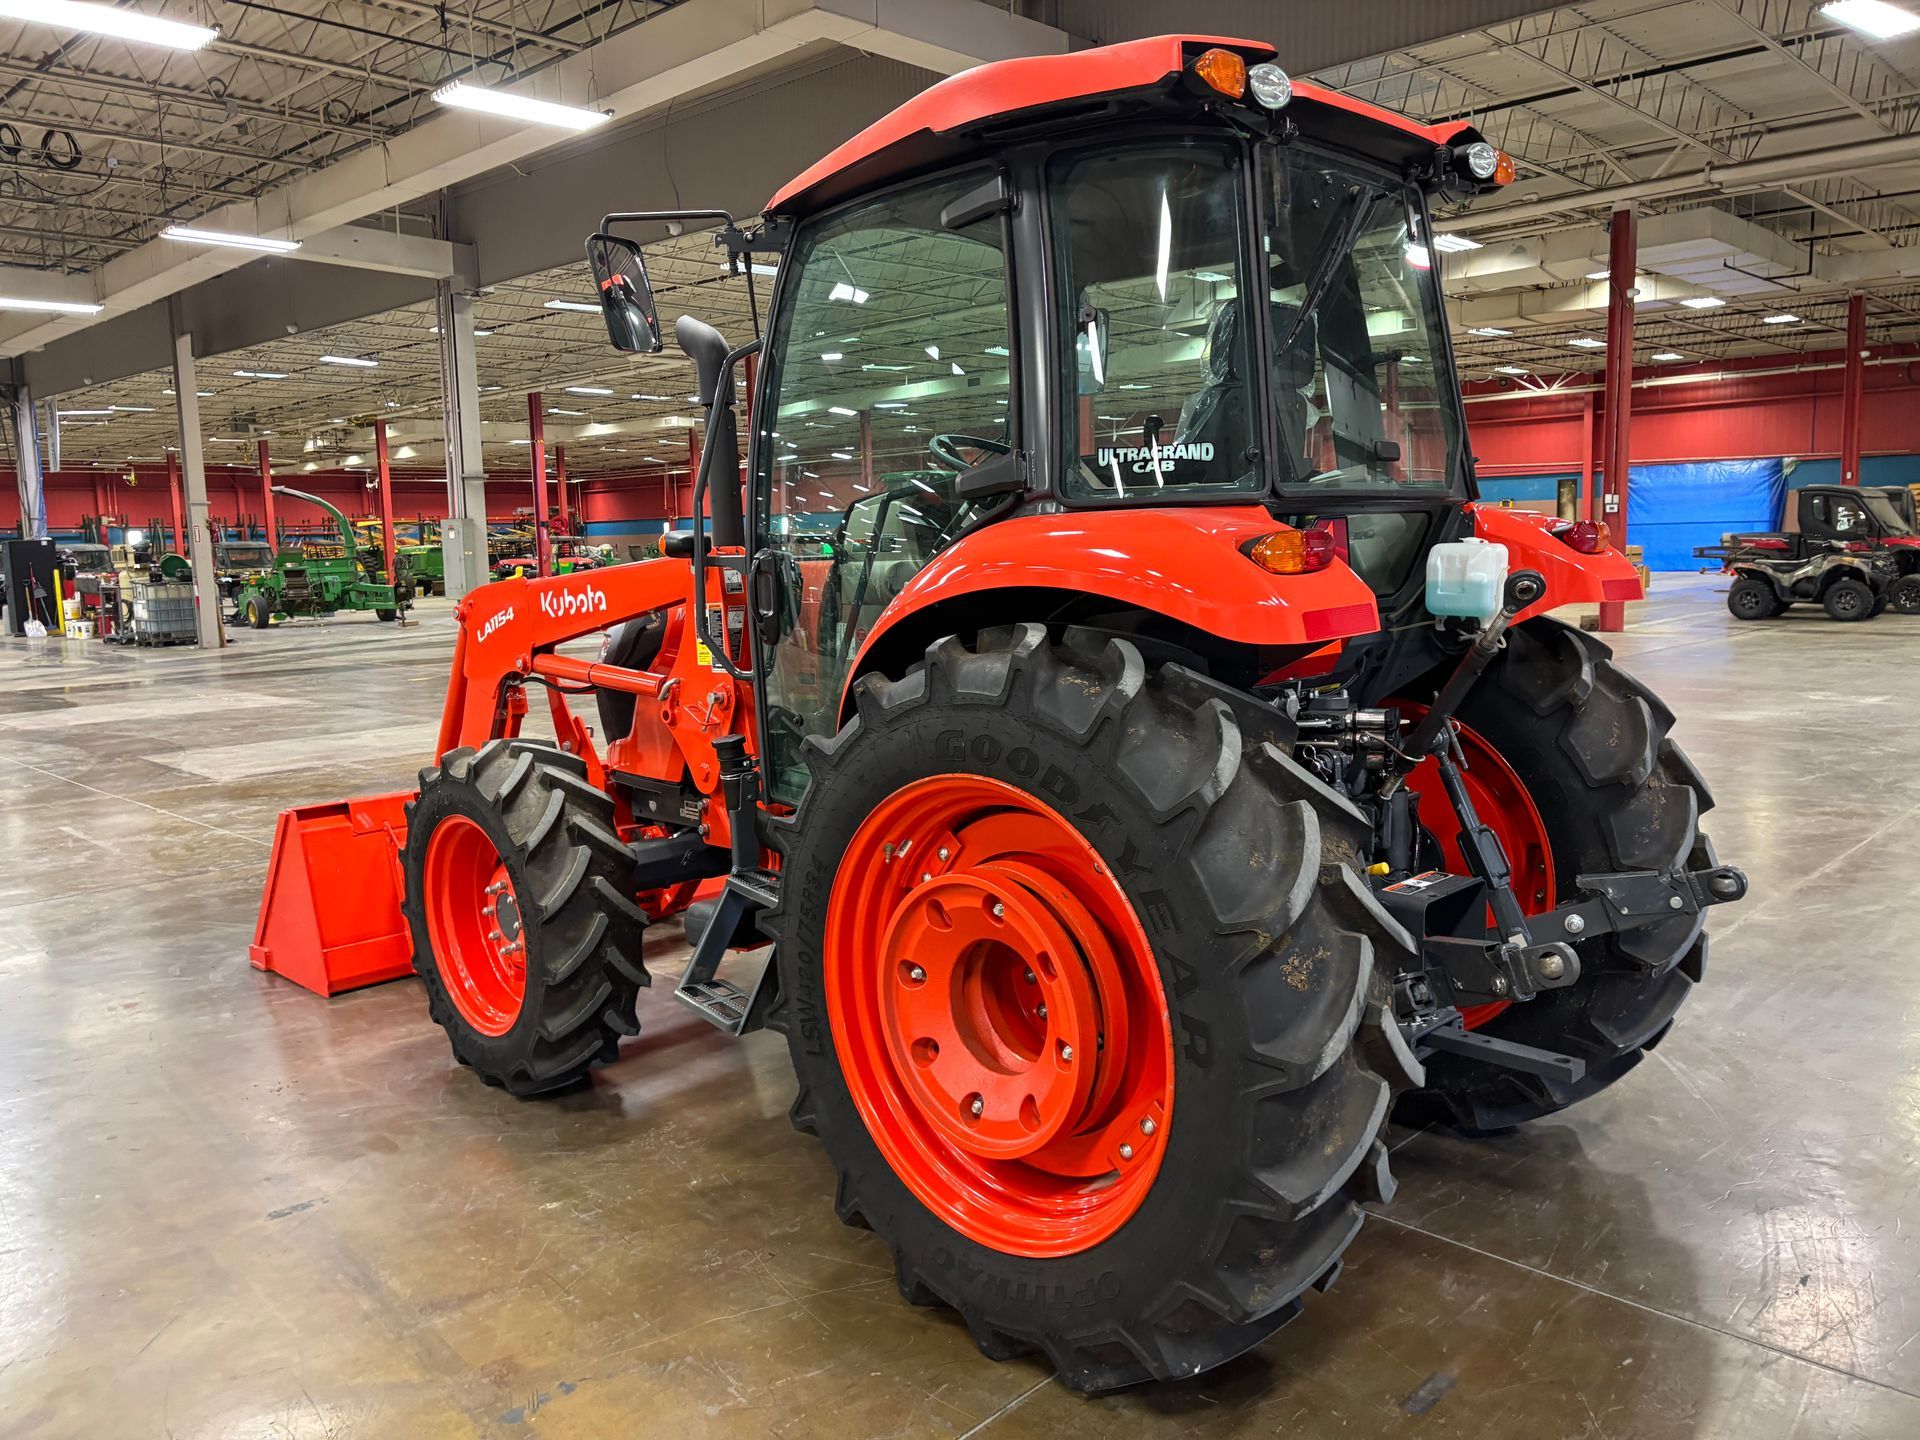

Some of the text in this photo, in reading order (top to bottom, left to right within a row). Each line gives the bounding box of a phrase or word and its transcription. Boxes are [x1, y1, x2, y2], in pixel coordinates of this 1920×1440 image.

[1097, 442, 1215, 467] ULTRAGRAND
[1132, 460, 1176, 474] CAB
[540, 584, 607, 618] Kubota
[476, 606, 515, 643] LA1154
